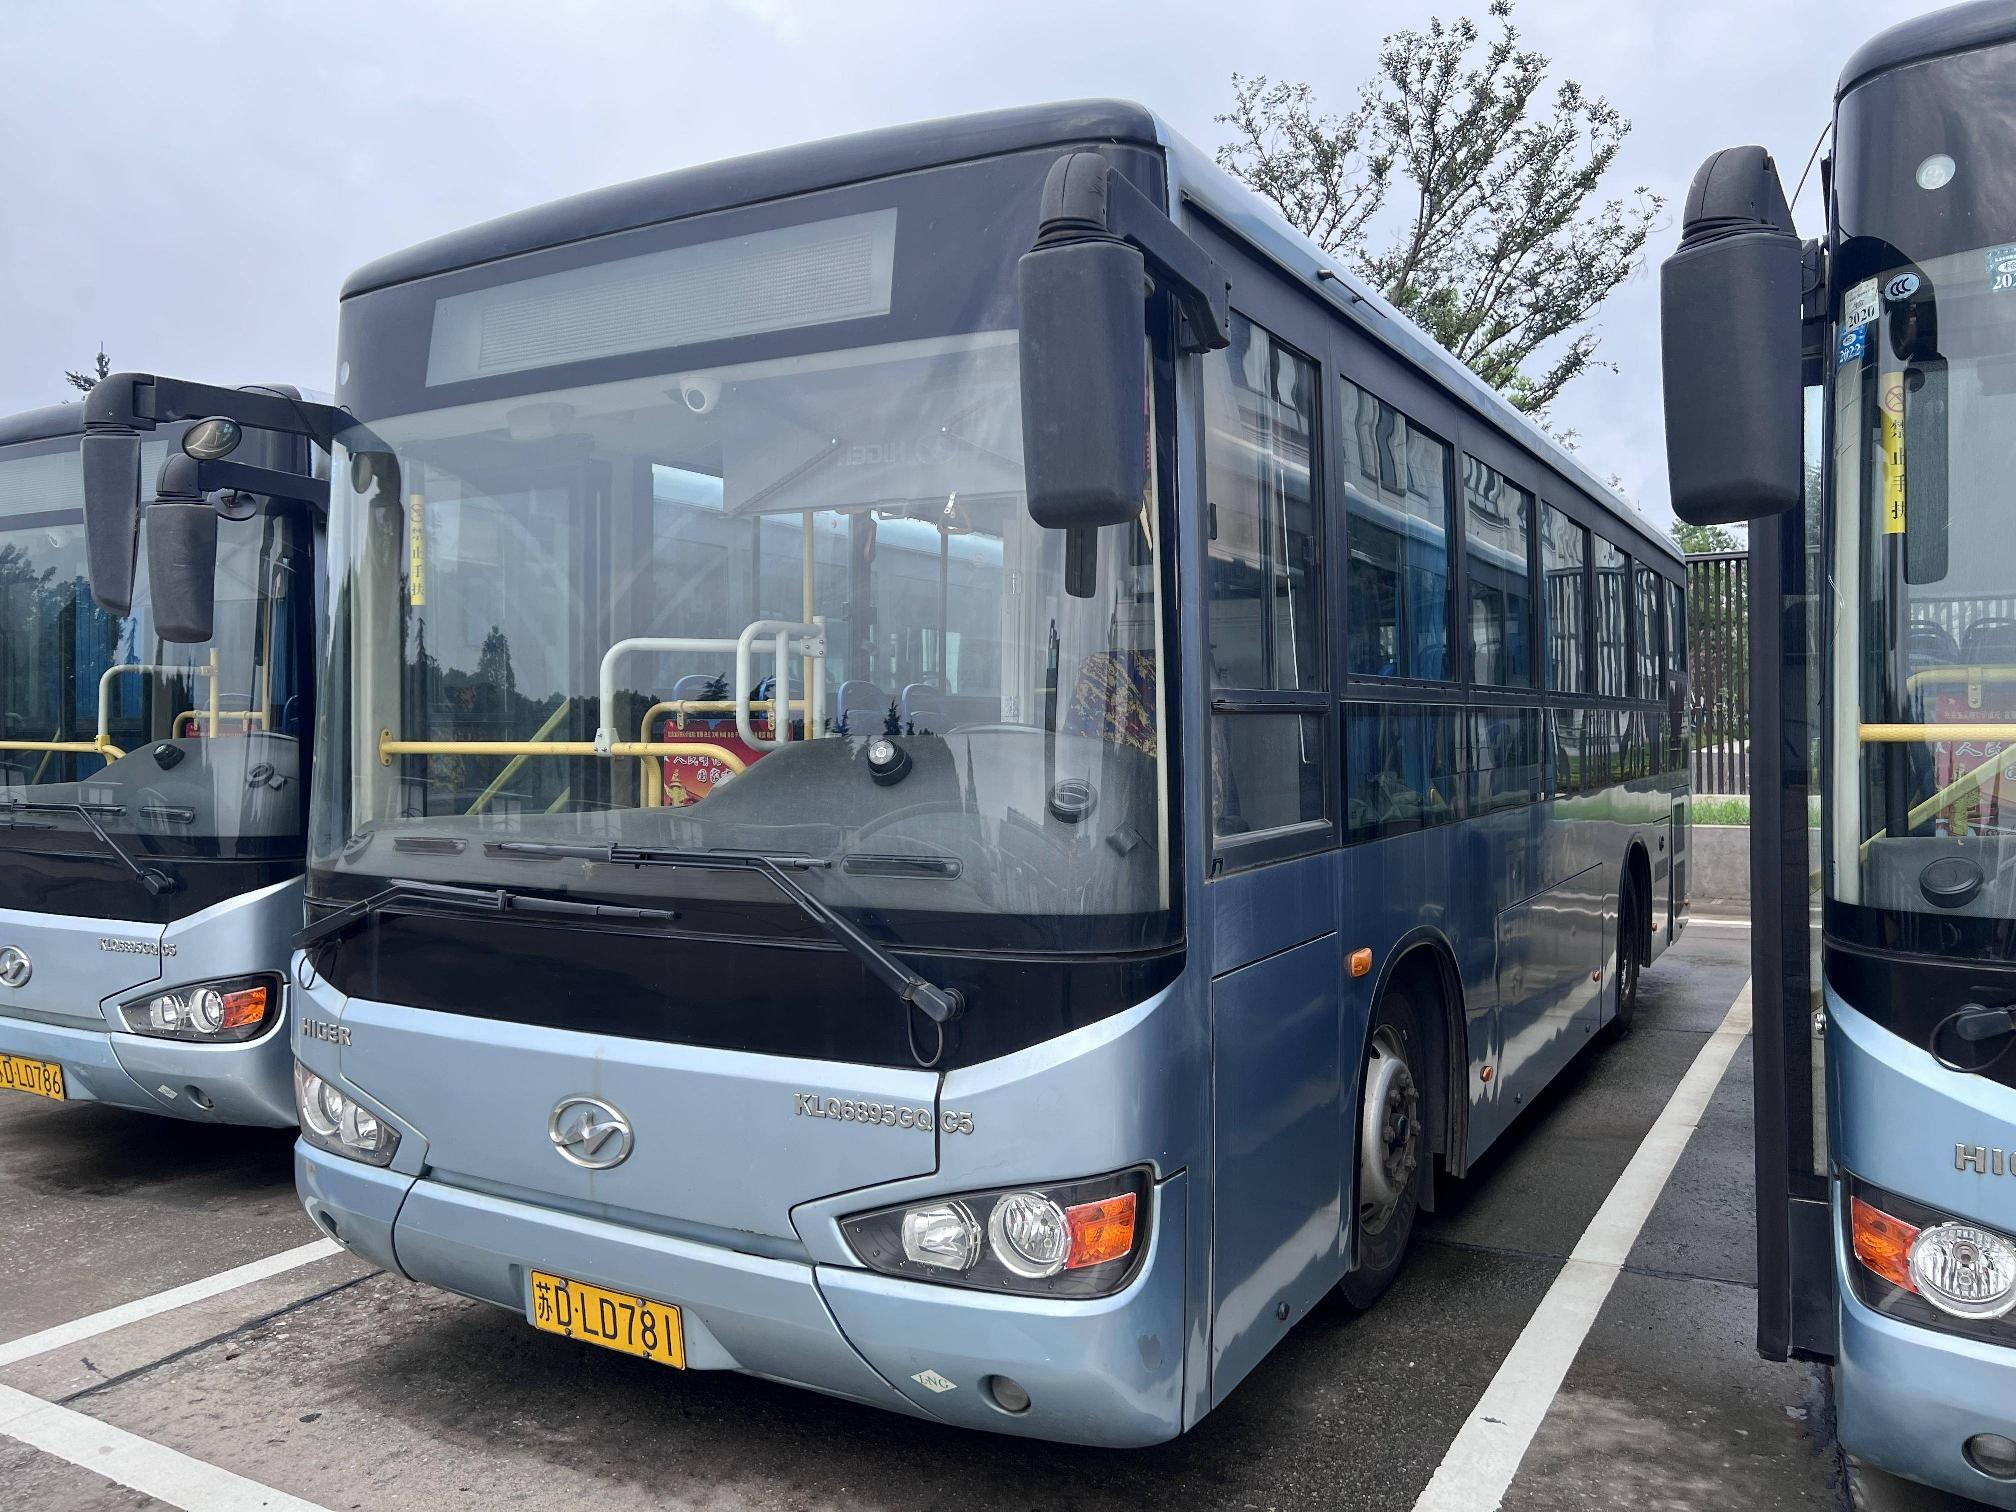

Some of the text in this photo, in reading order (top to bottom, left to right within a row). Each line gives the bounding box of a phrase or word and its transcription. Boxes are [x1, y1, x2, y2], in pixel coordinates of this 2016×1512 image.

[1992, 273, 2016, 290] 20
[1848, 304, 1875, 328] 2020
[302, 1017, 352, 1047] HIGER
[1954, 1142, 2016, 1178] HI
